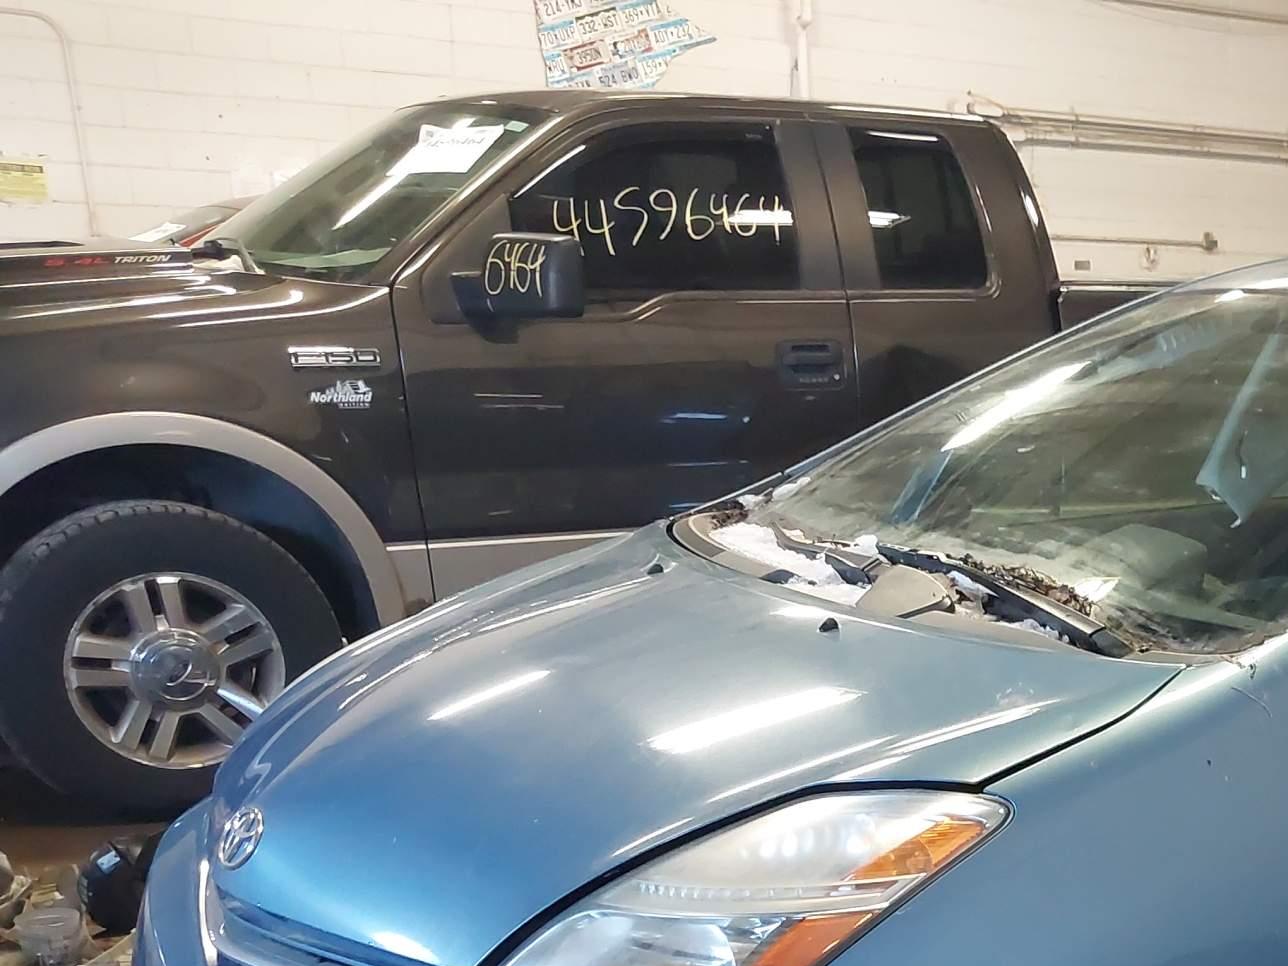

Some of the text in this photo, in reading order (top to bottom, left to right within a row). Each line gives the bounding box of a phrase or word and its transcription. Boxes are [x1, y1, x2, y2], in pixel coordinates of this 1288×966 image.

[553, 187, 790, 256] 44596464
[113, 254, 172, 264] TRITON
[485, 239, 546, 298] 6464
[310, 391, 373, 403] Northland
